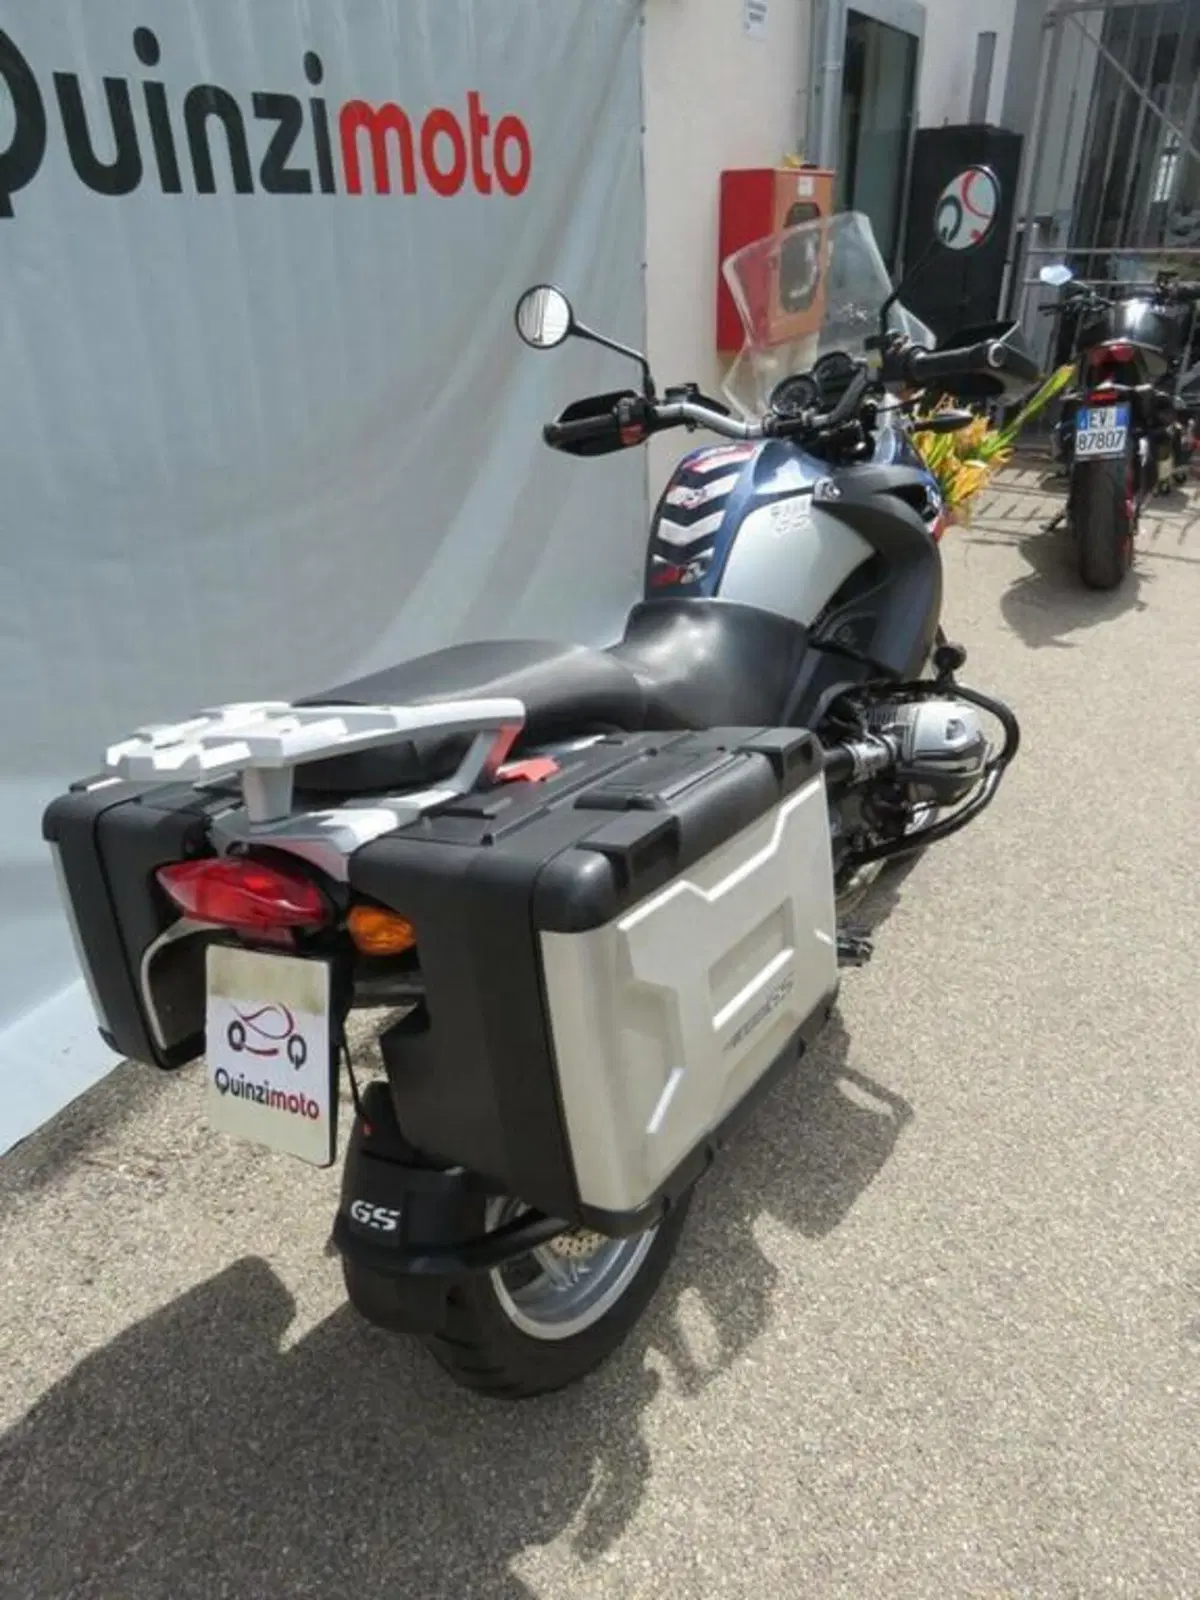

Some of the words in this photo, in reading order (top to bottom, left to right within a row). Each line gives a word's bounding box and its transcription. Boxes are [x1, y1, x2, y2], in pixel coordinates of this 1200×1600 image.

[1089, 409, 1107, 429] EV
[1078, 429, 1125, 451] 87807
[214, 1067, 320, 1120] Quinzimoto
[351, 1199, 401, 1231] GS
